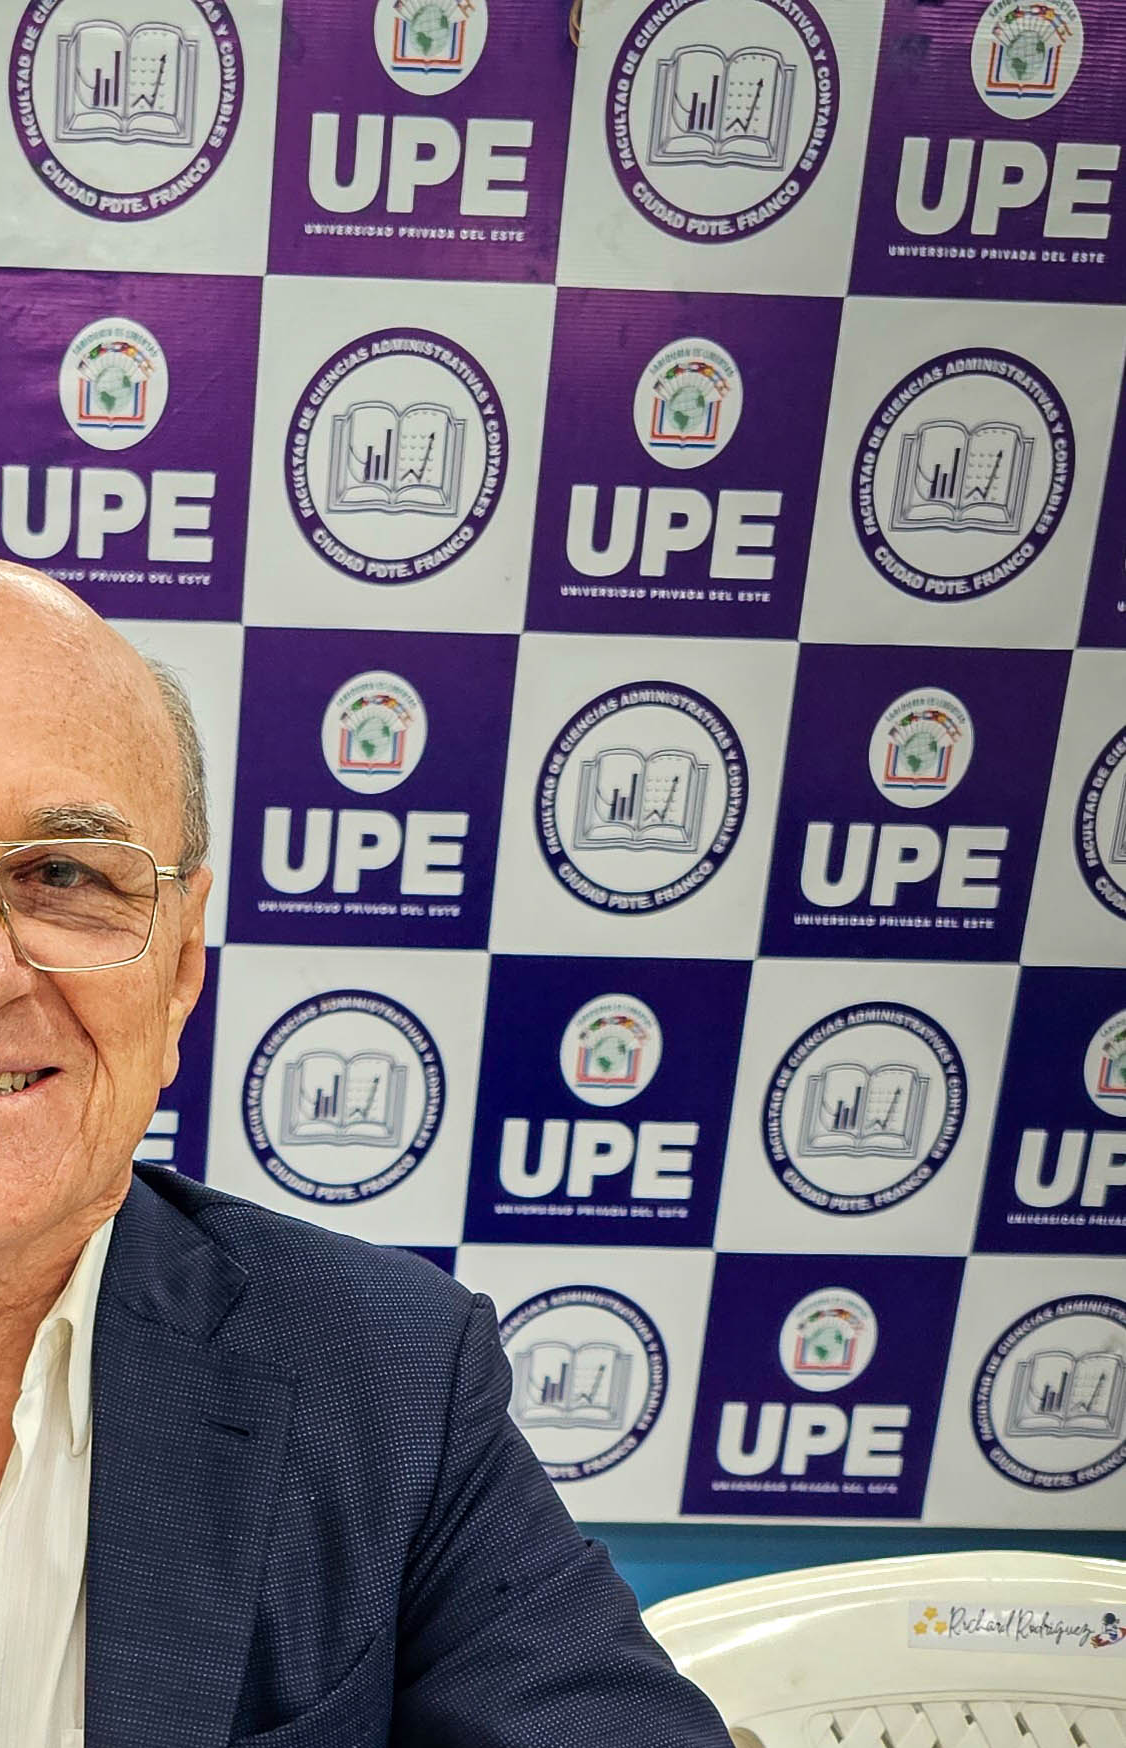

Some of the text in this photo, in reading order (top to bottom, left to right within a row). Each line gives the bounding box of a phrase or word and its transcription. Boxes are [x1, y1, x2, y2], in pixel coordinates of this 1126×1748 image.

[798, 63, 832, 175] CONTABLES
[309, 113, 533, 217] UPE
[630, 178, 687, 231] CIUDAD
[736, 176, 801, 232] FRANCO
[896, 137, 1120, 239] UPE
[291, 335, 501, 520] FACULTAD DE CIENCIAS ADMINISTRATIVAS Y CONTABLES
[858, 355, 1068, 538] FACULTAD DE CIENCIAS ADMINISTRATIVAS Y CONTABLES
[2, 465, 215, 562] UPE
[311, 525, 366, 574] CIUDAD
[413, 522, 475, 574] FRANCO
[567, 485, 781, 579] UPE
[873, 542, 926, 590] CIUDAD
[972, 539, 1036, 591] FRANCO
[262, 807, 468, 895] UPE
[801, 822, 1008, 908] UPE
[500, 1118, 698, 1199] UPE
[718, 1402, 909, 1476] UPE
[949, 1606, 1014, 1638] Richard
